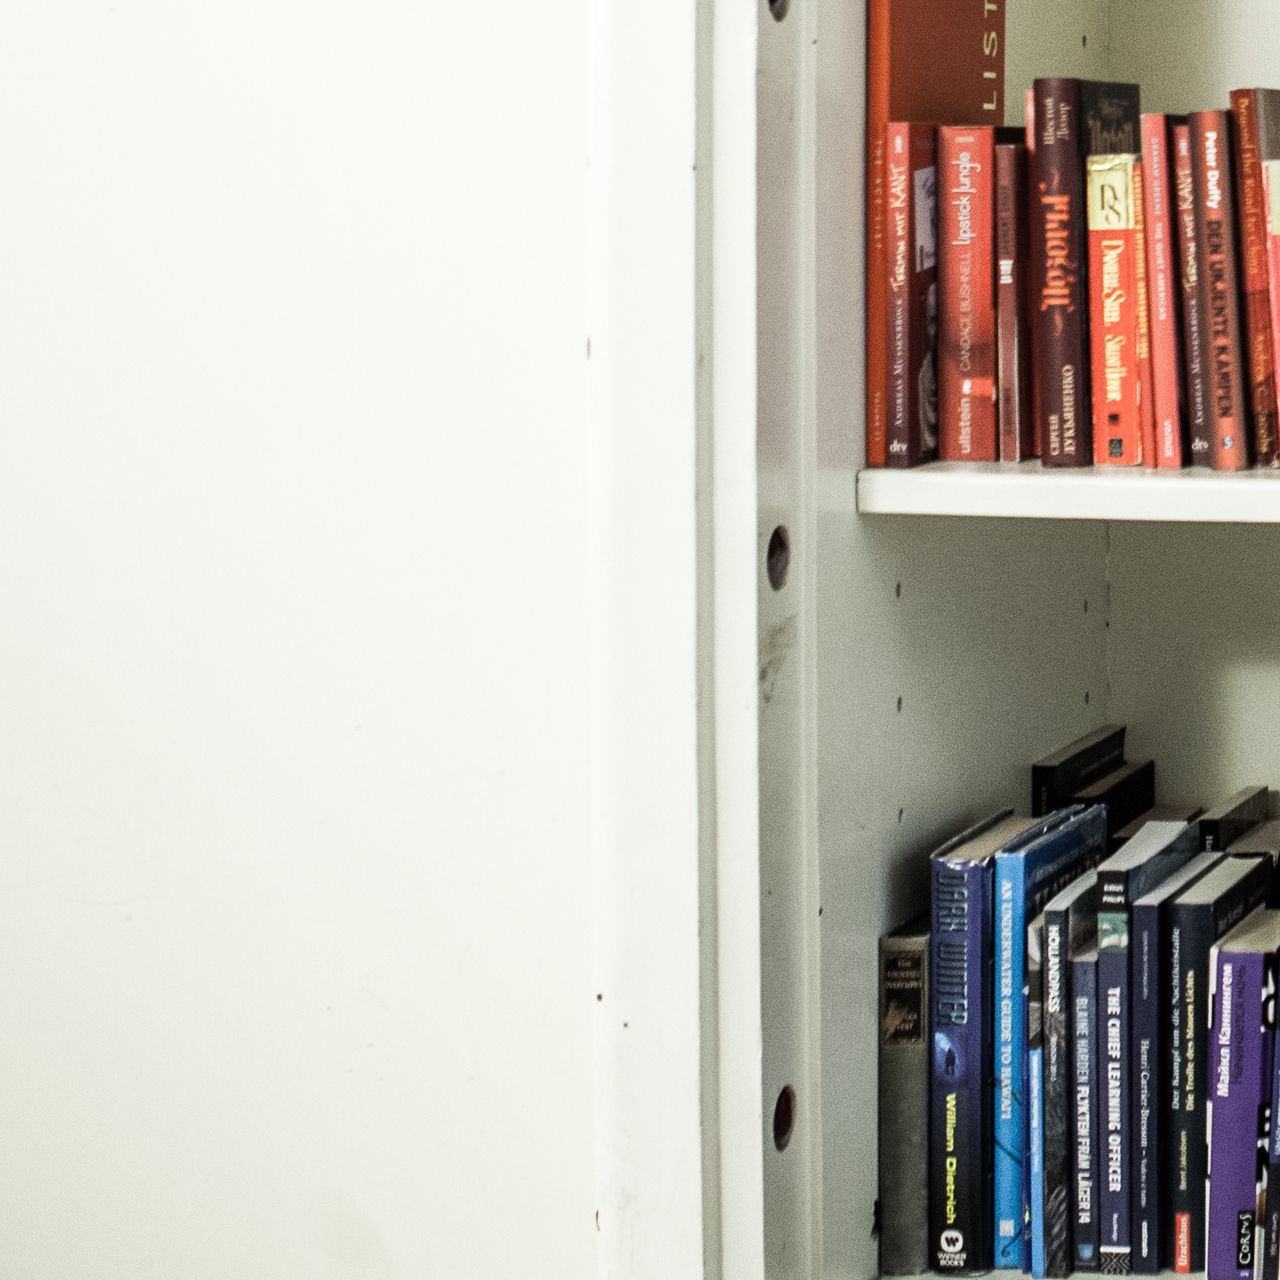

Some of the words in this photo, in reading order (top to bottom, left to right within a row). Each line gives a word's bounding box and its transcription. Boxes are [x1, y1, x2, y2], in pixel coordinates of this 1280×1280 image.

[1205, 131, 1218, 168] Peter
[889, 164, 906, 209] KANT
[1206, 170, 1222, 209] Duffy
[952, 195, 977, 246] lipstick
[1206, 220, 1223, 255] DEN
[960, 251, 972, 312] BUSHNELL
[960, 316, 973, 372] CANDACE
[959, 397, 973, 455] ullstein
[936, 871, 968, 933] DARK
[1000, 880, 1012, 900] AN
[1000, 902, 1012, 995] UNDERWATER
[1047, 925, 1061, 1012] HOLLANDPASS
[936, 939, 968, 1025] WINTER
[1106, 986, 1120, 1013] THE
[1218, 963, 1233, 1045] Каннингем
[1000, 998, 1012, 1042] GUIDE
[1075, 996, 1090, 1036] BLAINE
[1106, 1016, 1121, 1058] CHIEF
[1000, 1045, 1012, 1064] TO
[1076, 1038, 1090, 1082] HARDEN
[1139, 1037, 1150, 1069] Henri
[1215, 1046, 1231, 1098] Майкл
[945, 1091, 957, 1151] William
[1075, 1084, 1091, 1135] FLYKTEN
[1107, 1061, 1122, 1130] LEARNING
[1185, 1094, 1194, 1112] Die
[1076, 1137, 1095, 1169] FRÅN
[1107, 1133, 1121, 1192] OFFICER
[945, 1155, 958, 1225] Dietrich
[1078, 1170, 1095, 1210] LÄGER
[1176, 1215, 1189, 1267] Urachhaus
